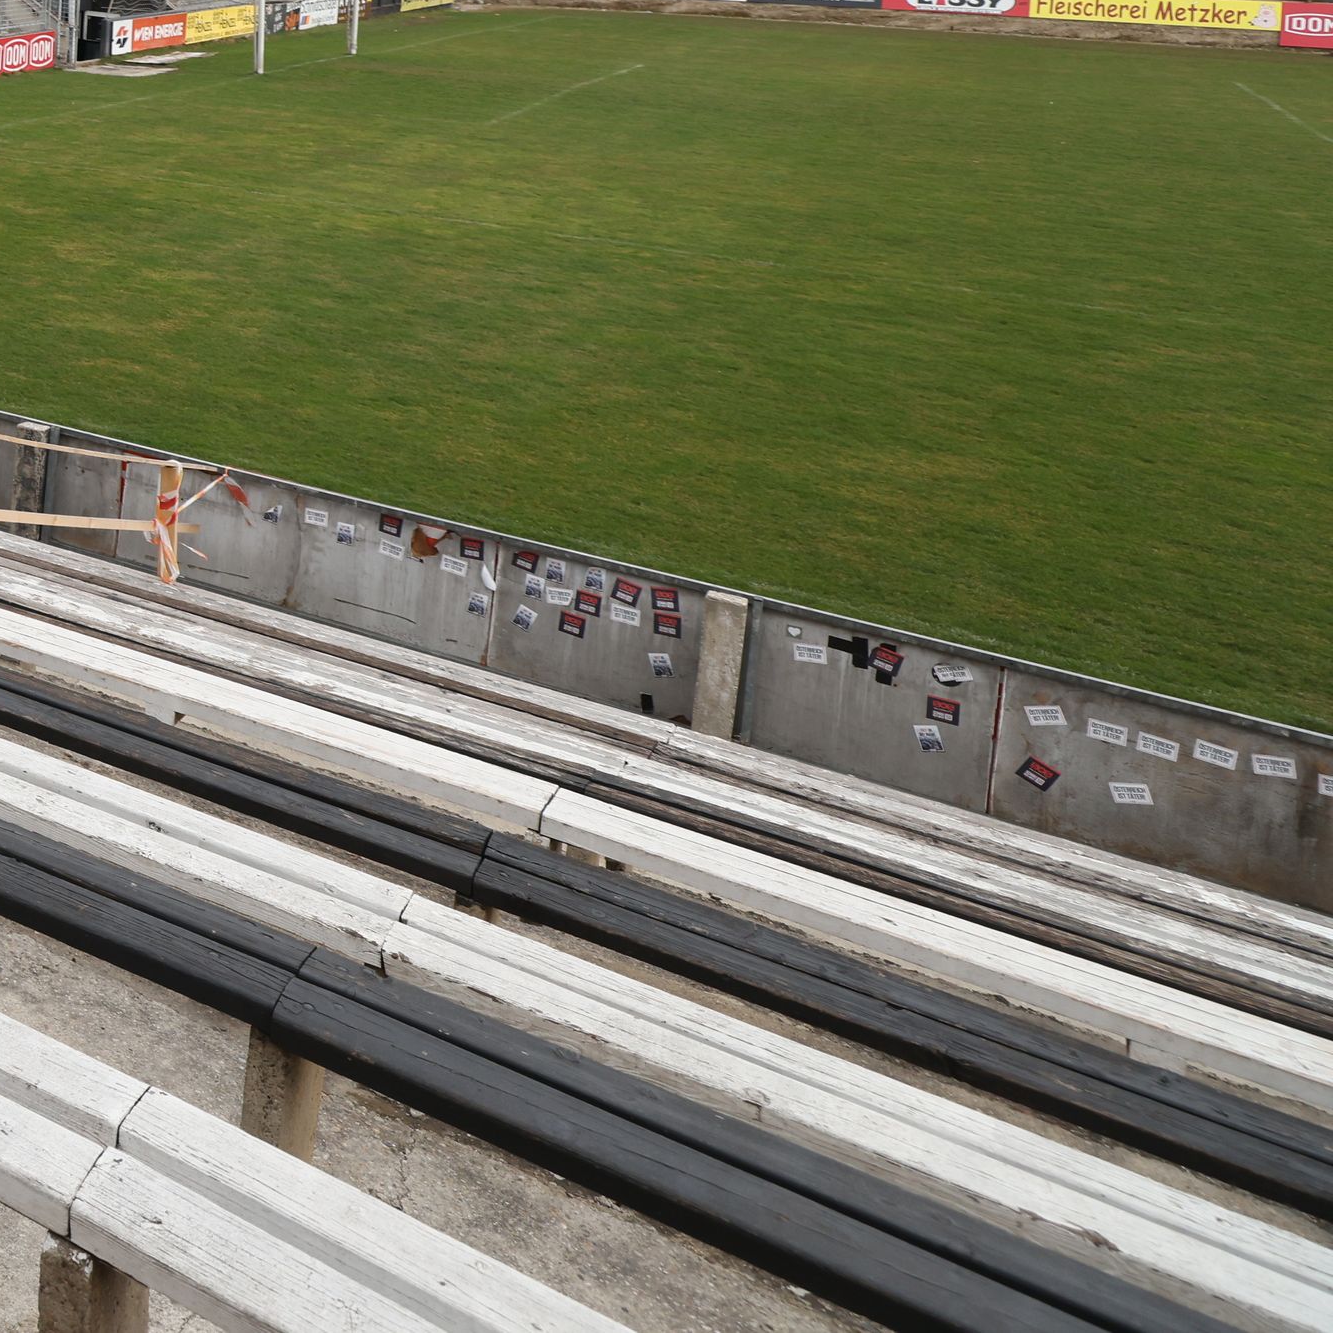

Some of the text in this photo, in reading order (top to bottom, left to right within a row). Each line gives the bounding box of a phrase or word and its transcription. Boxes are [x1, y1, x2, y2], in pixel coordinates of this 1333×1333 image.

[1155, 1, 1247, 25] Metzker
[133, 25, 153, 42] WIEN
[154, 22, 184, 39] ENERGIE
[6, 46, 26, 67] DOM
[32, 40, 52, 62] DOM
